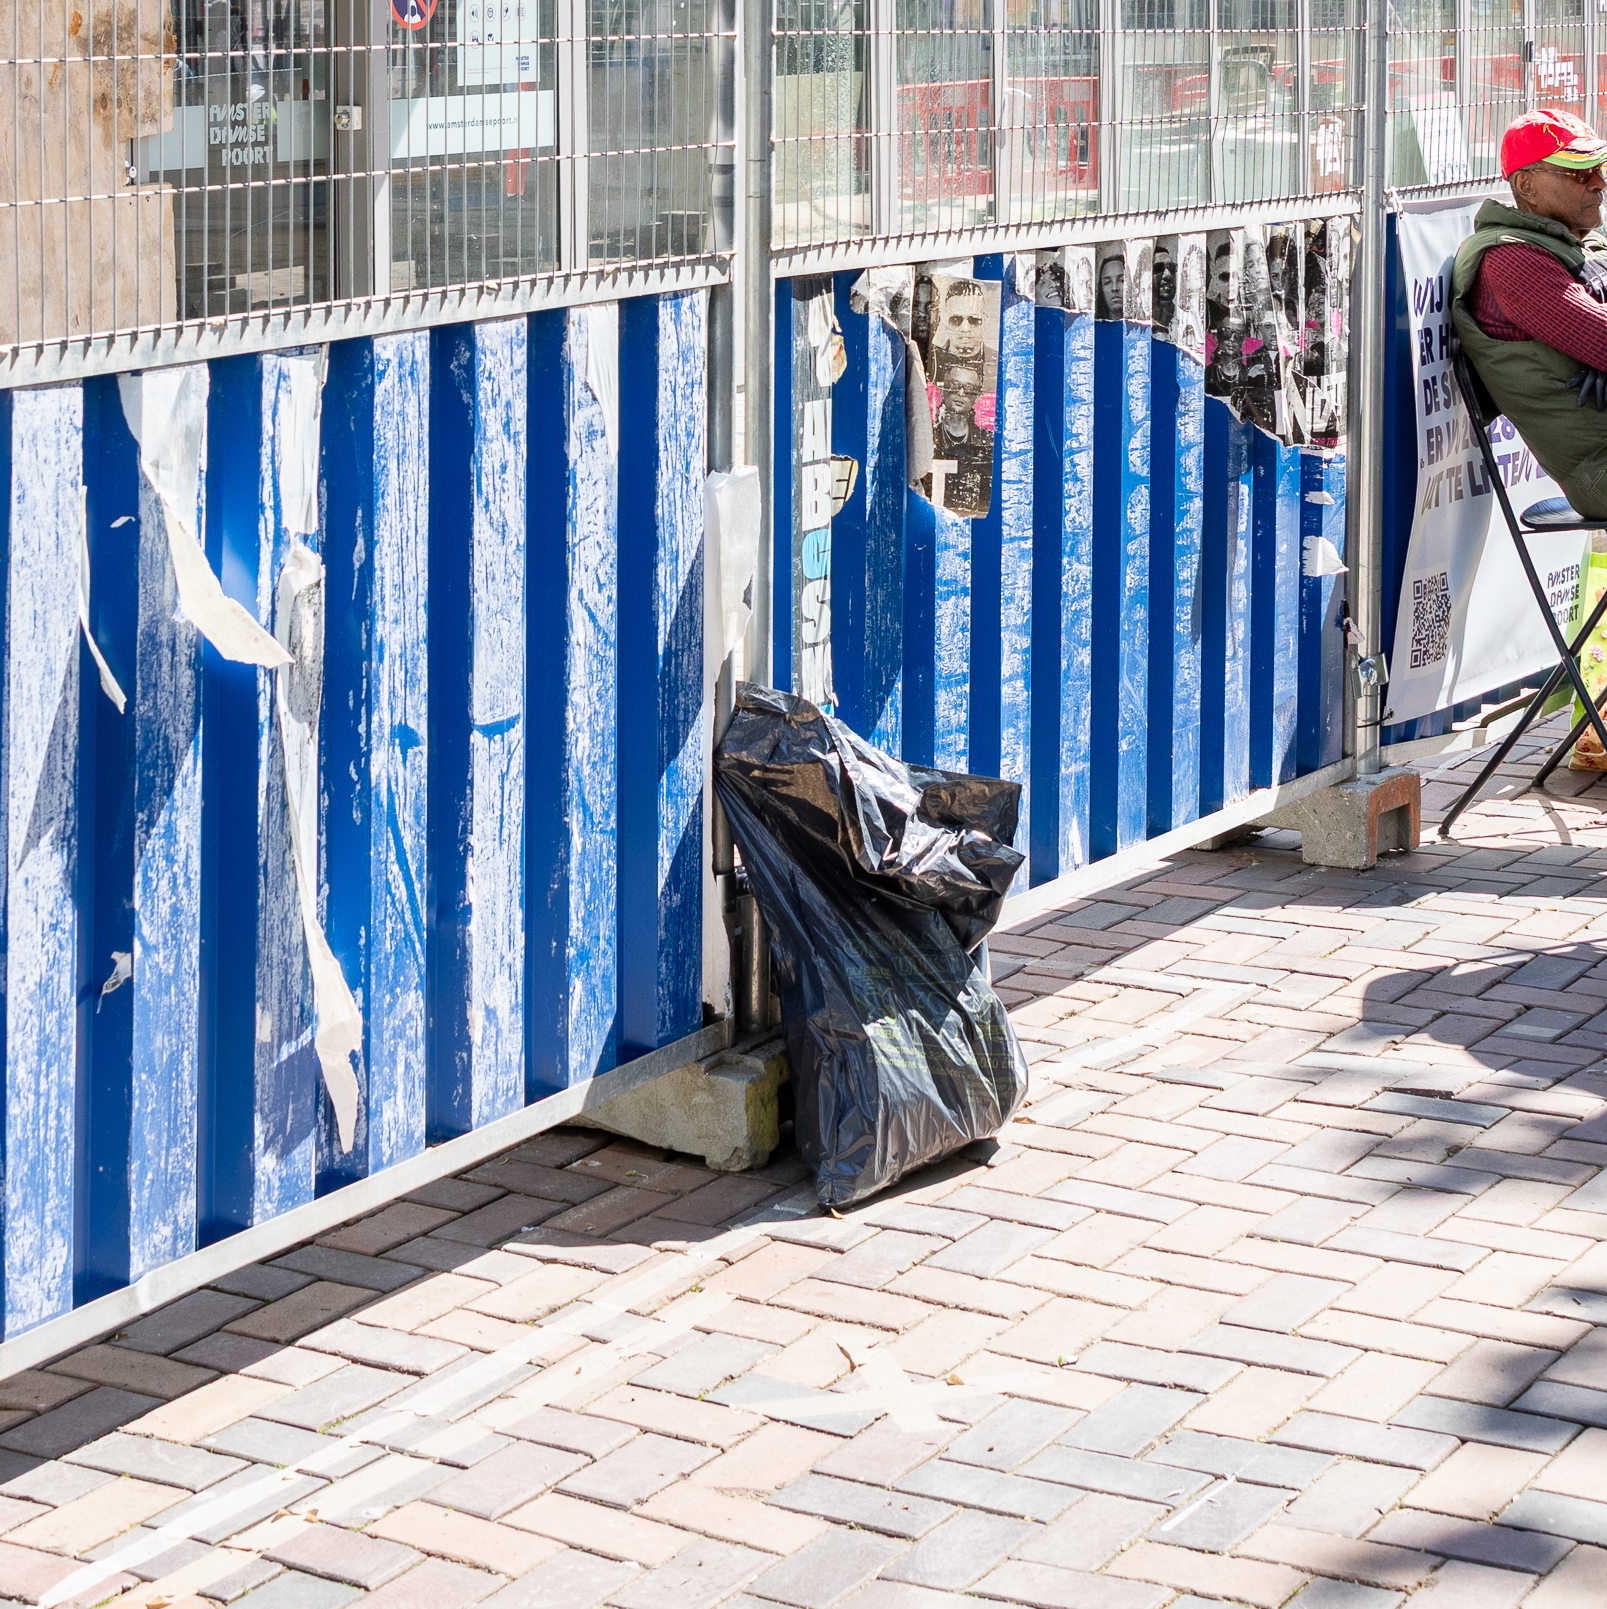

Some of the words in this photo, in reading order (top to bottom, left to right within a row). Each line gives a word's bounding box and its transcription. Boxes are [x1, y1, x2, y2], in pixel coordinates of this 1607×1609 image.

[209, 101, 269, 123] AMSTER
[209, 124, 266, 145] DAMSE
[221, 146, 273, 167] POORT
[1414, 276, 1443, 318] WIJ
[1418, 327, 1434, 367] ER
[1423, 375, 1440, 416] DE
[1426, 426, 1444, 466] ER
[1446, 464, 1464, 504] TE
[1467, 447, 1532, 498] LATEN
[1547, 563, 1580, 589] AMSTER
[1550, 584, 1579, 607] DAMSE
